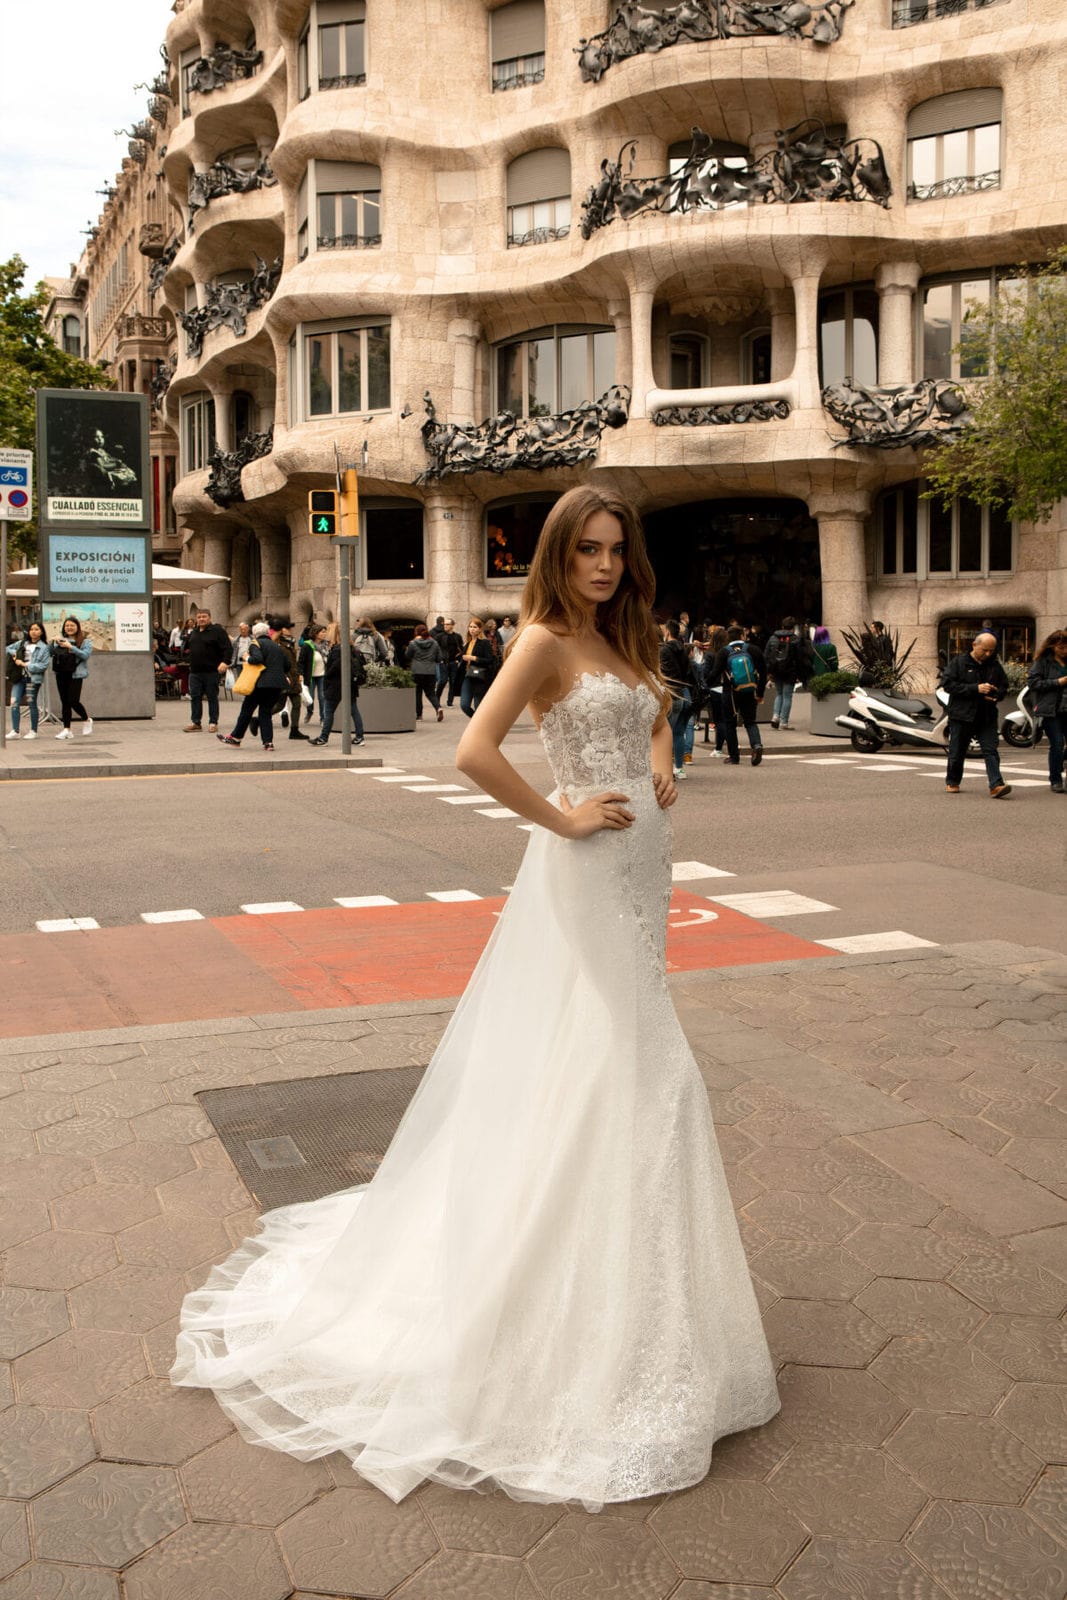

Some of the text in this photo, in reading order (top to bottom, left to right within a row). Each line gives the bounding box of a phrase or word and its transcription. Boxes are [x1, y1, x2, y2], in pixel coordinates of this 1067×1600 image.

[52, 500, 140, 512] CUALLADÓ ESSENCIAL
[112, 577, 129, 585] junio
